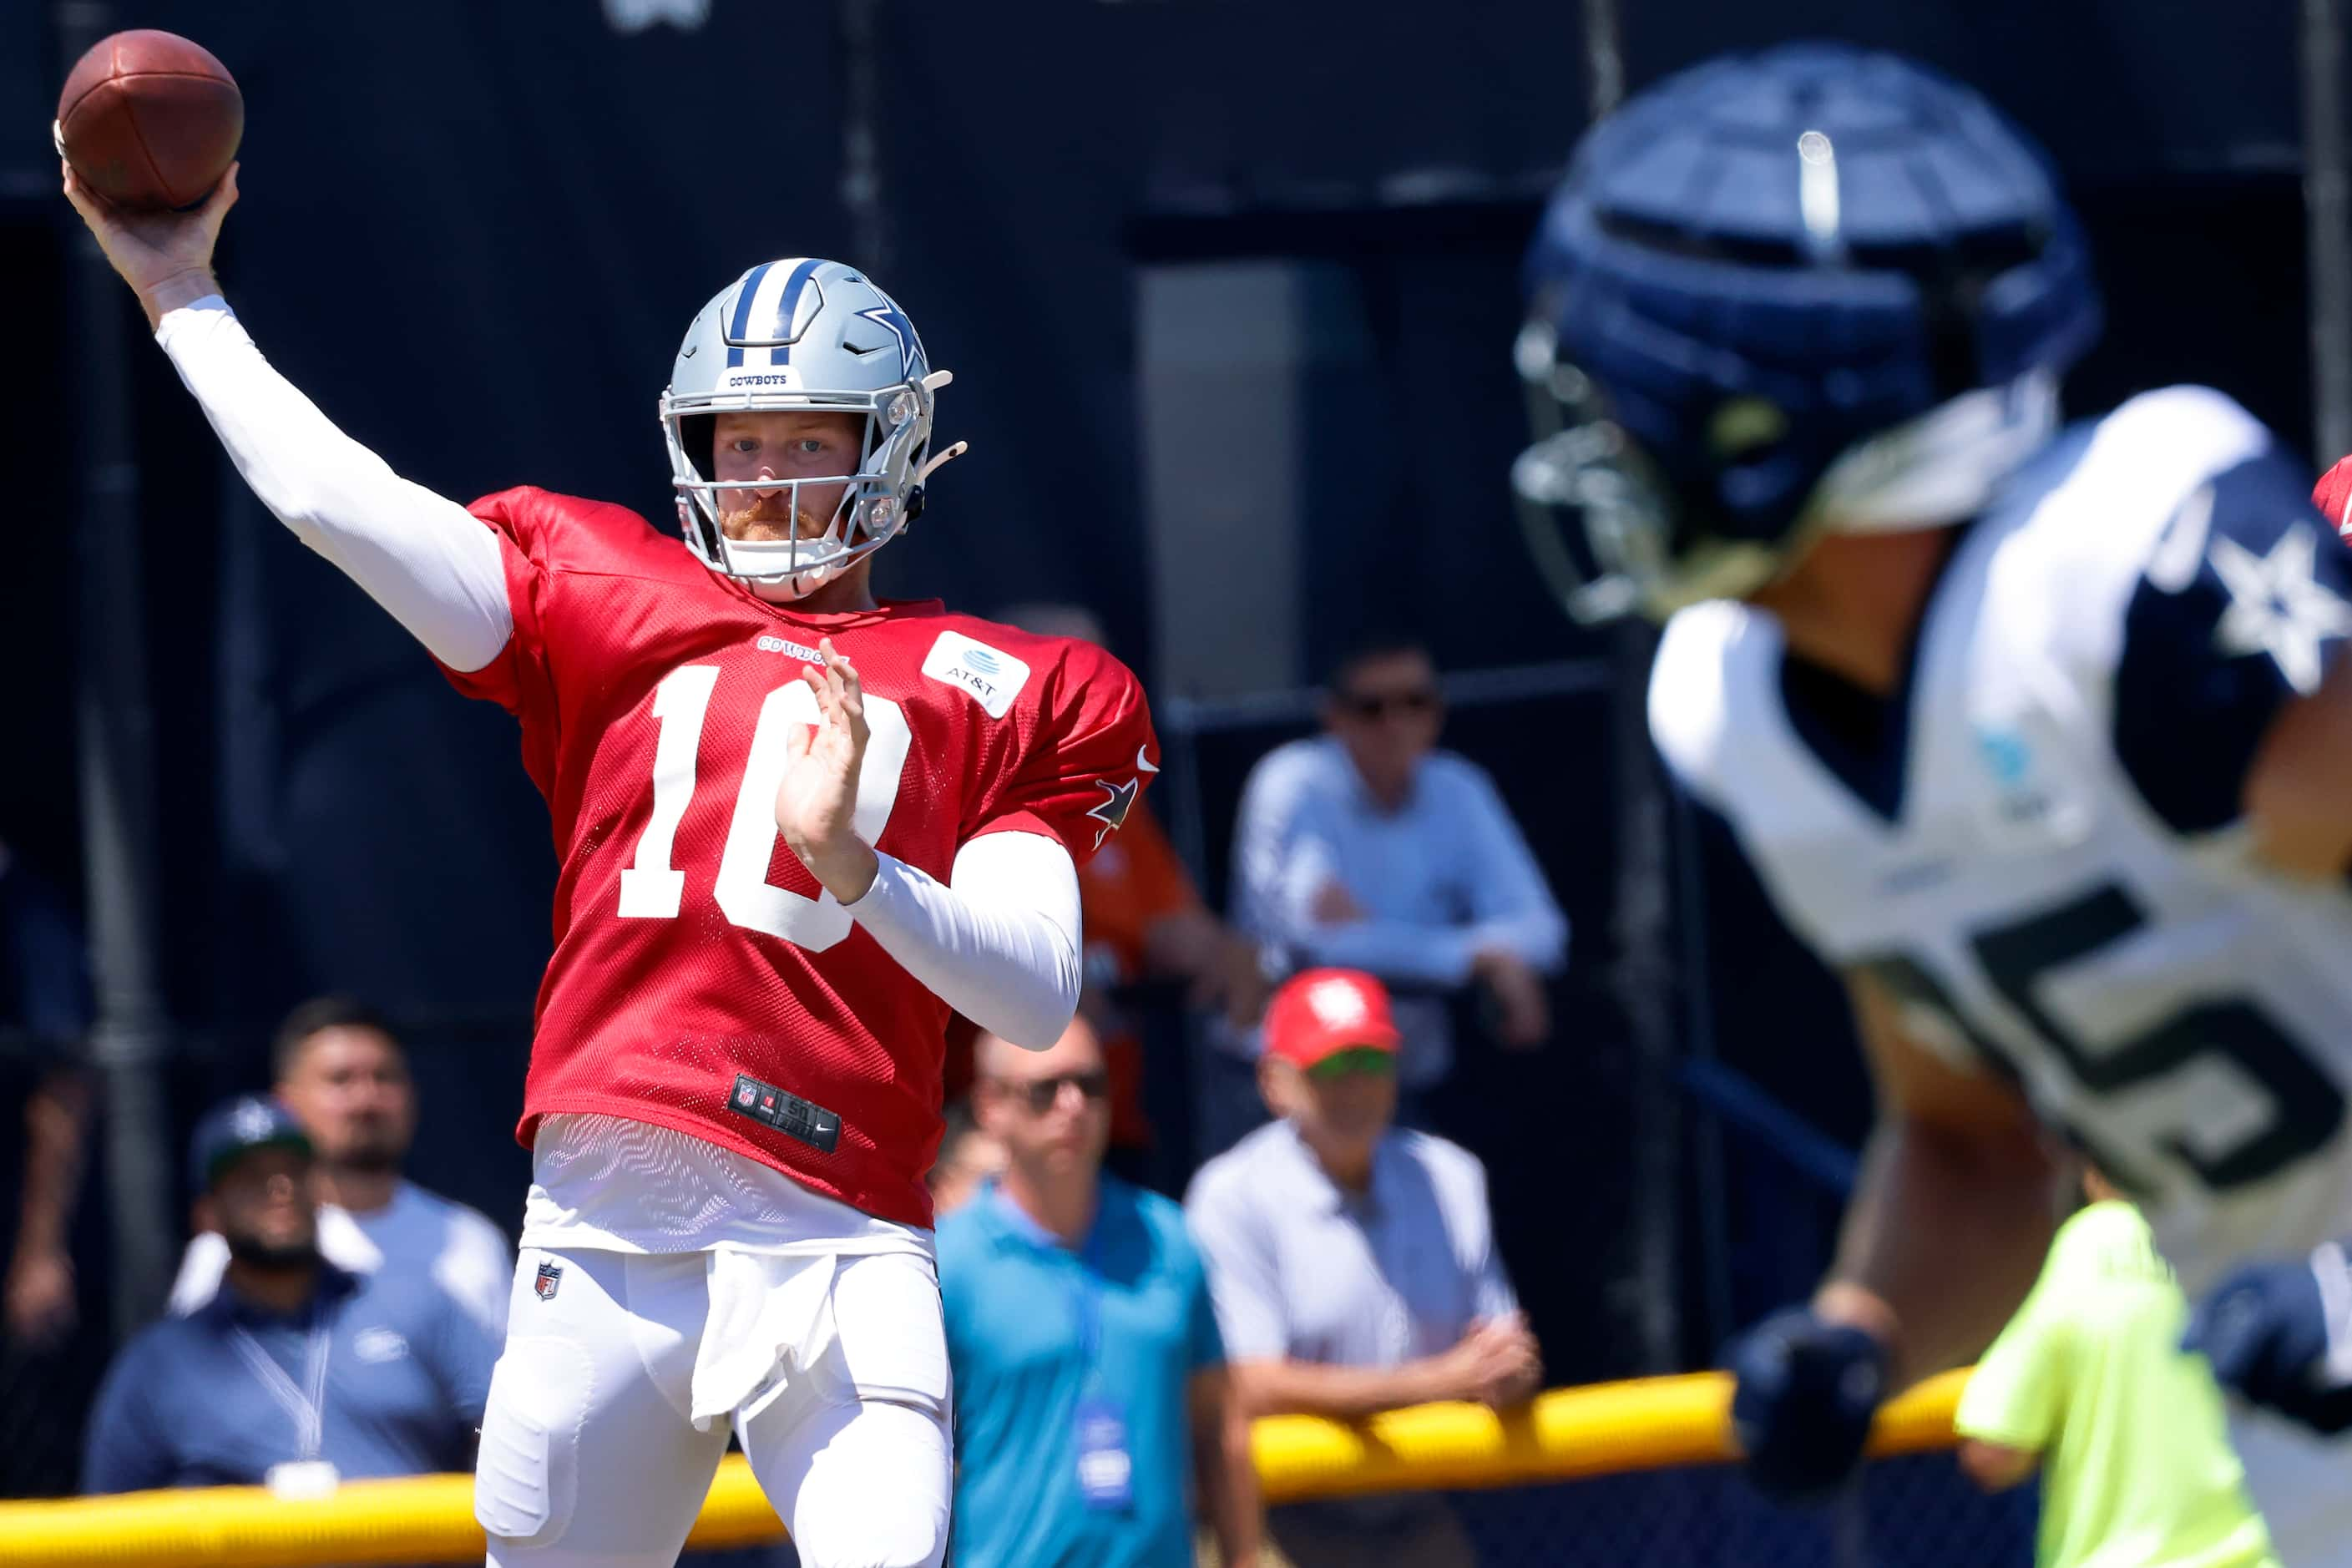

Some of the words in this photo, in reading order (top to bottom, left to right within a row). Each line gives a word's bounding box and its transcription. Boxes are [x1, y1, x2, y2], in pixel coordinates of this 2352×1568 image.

[730, 375, 787, 387] COWBOYS
[758, 636, 850, 666] COWBO
[945, 667, 997, 696] AT&T
[617, 665, 912, 953] 10
